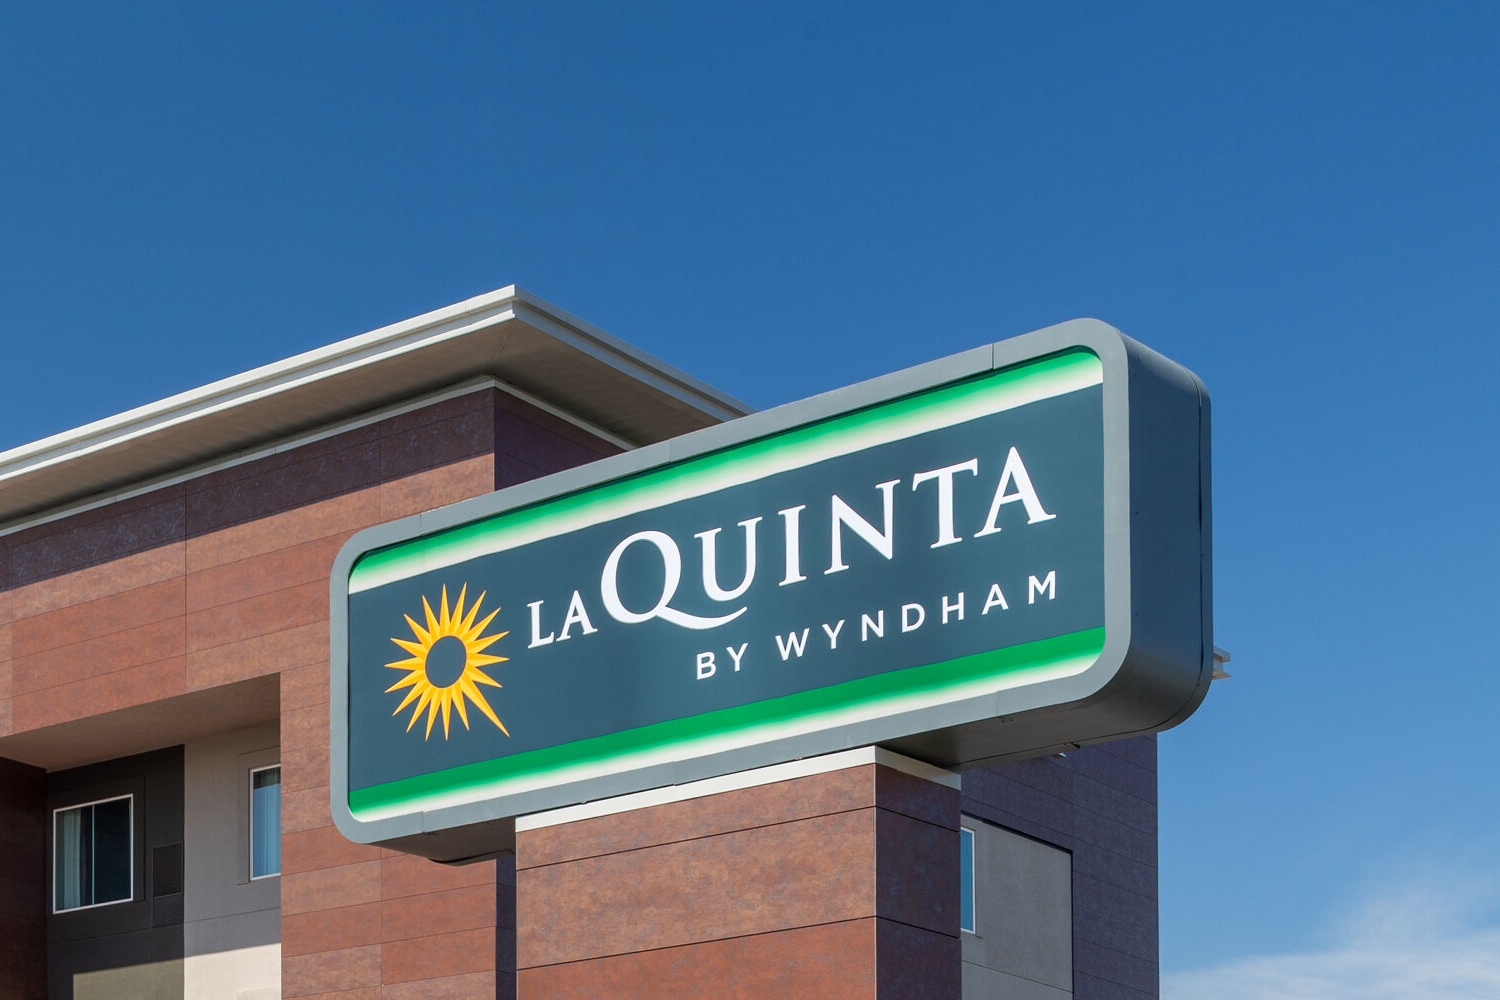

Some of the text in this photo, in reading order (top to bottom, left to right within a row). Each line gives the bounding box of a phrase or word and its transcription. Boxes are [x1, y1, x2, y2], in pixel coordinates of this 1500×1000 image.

[526, 446, 1057, 649] LA QUINTA
[696, 570, 1058, 680] BY WYNDHAM
